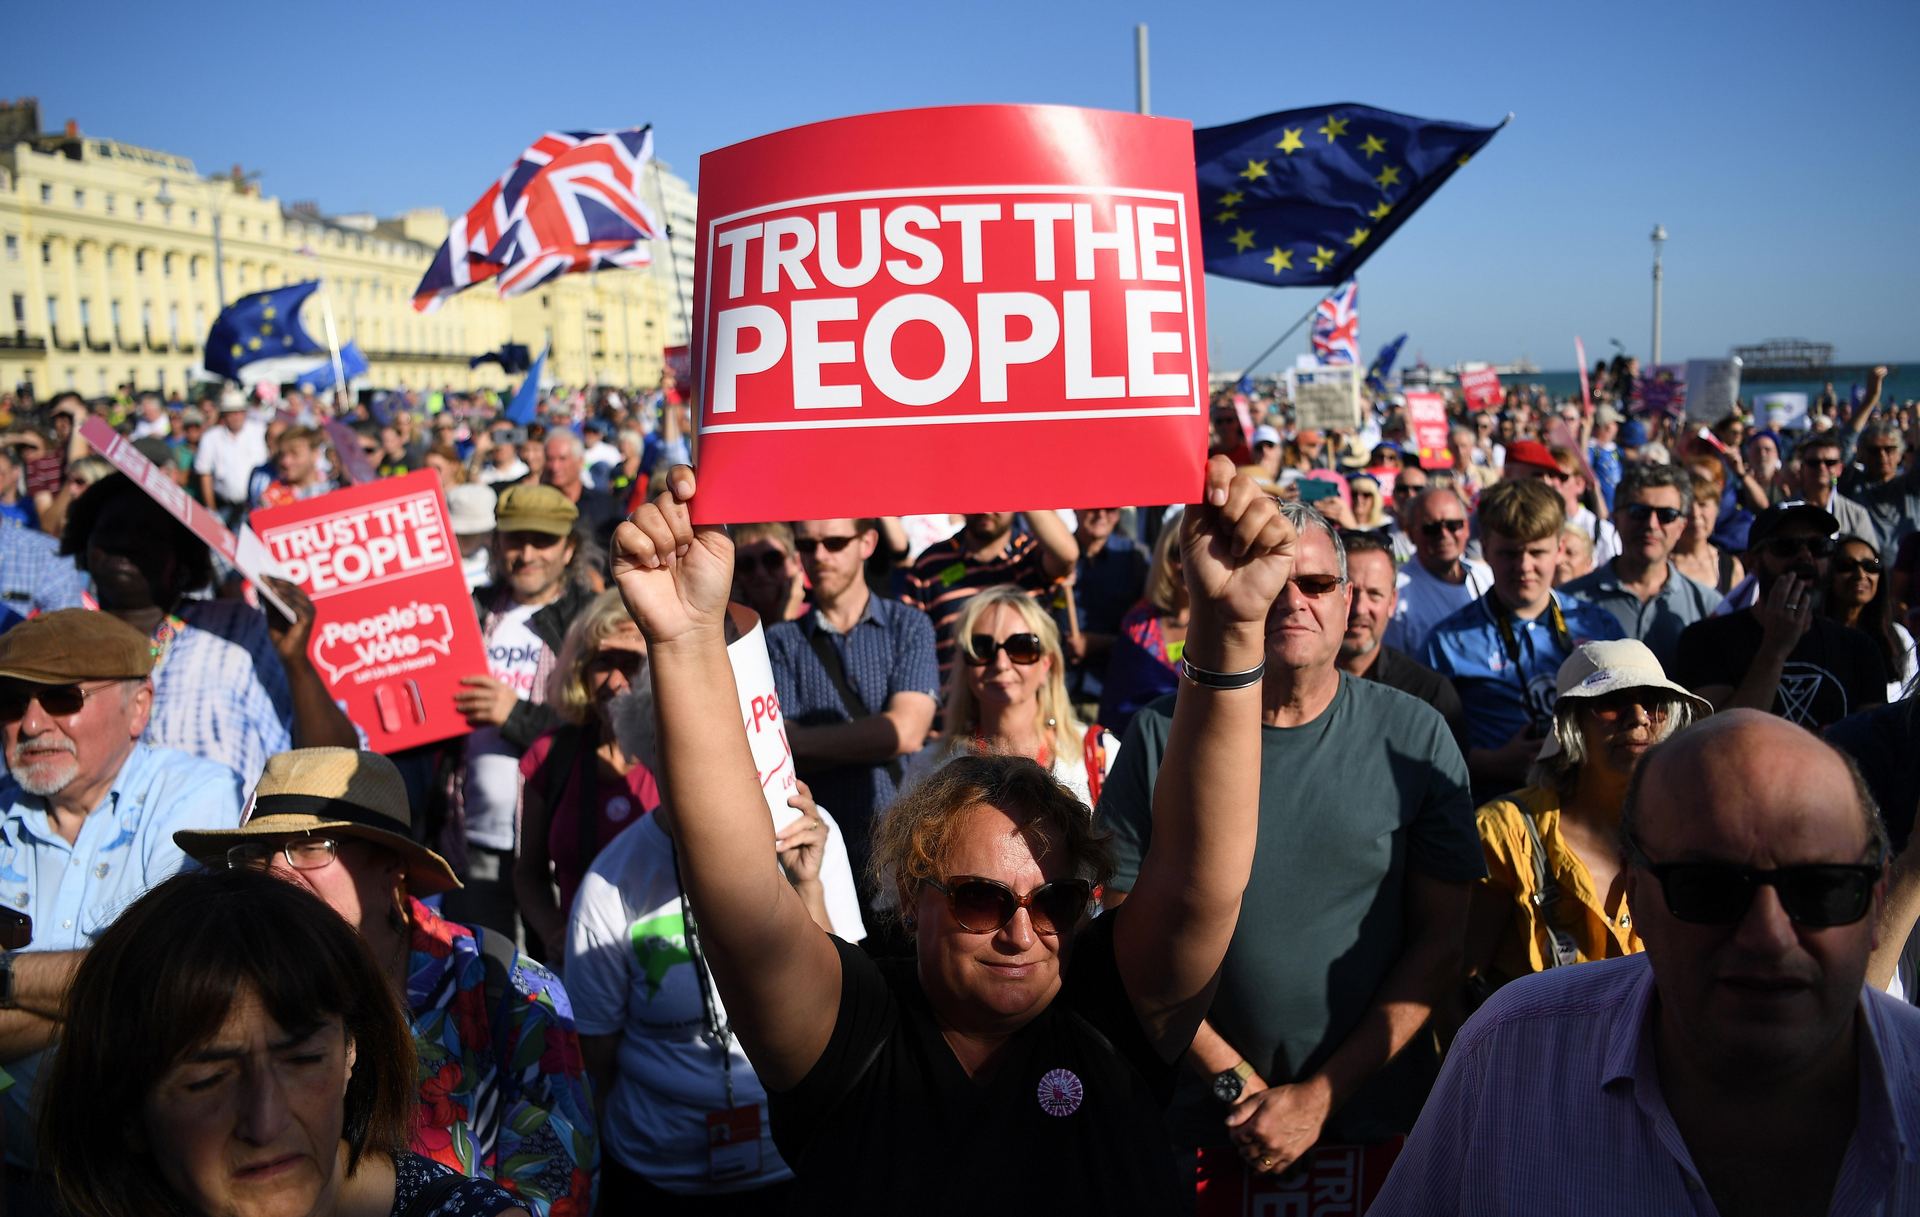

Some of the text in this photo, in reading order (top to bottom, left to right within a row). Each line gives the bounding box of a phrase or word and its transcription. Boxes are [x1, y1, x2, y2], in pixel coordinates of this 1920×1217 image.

[718, 203, 1180, 299] TRUST THE
[712, 290, 1190, 414] PEOPLE
[270, 512, 369, 560] TRUST
[374, 497, 437, 536] THE
[280, 526, 447, 592] PEOPLE
[321, 600, 435, 649] People's
[354, 634, 421, 666] Vote
[488, 644, 540, 668] ople
[497, 671, 534, 690] ote
[751, 687, 781, 733] Pe
